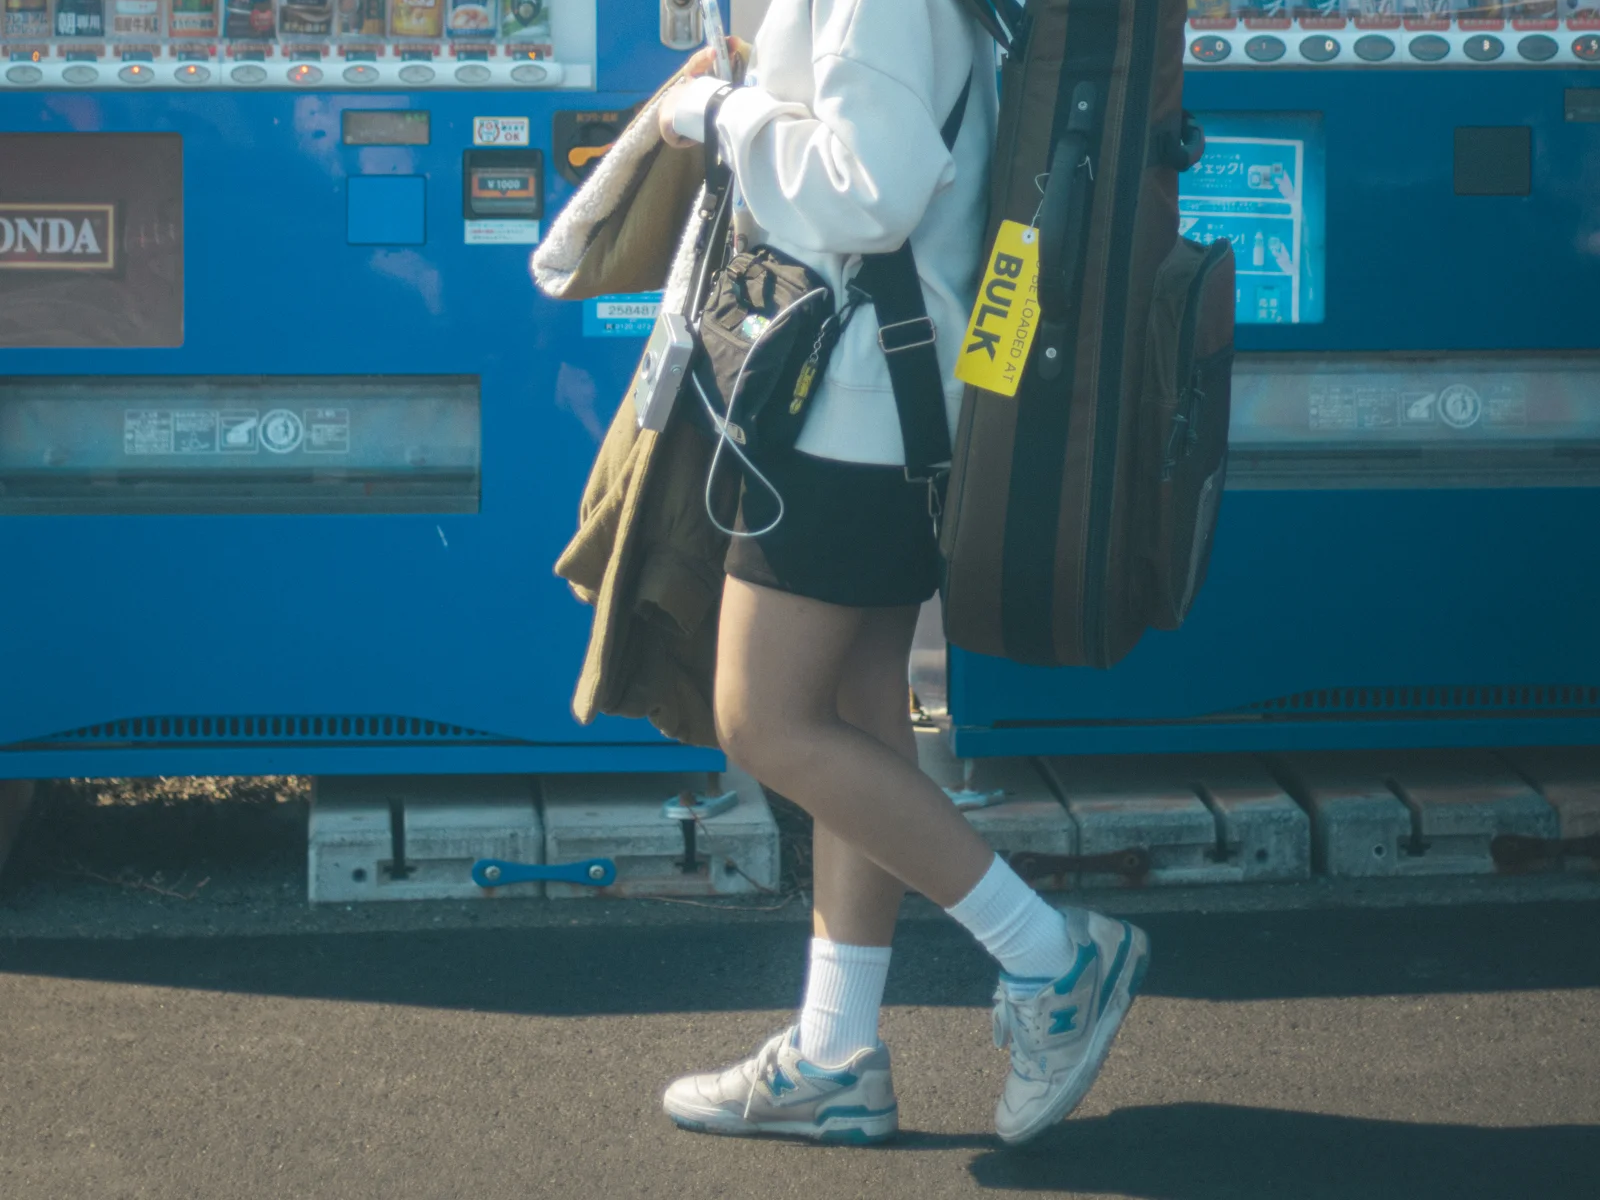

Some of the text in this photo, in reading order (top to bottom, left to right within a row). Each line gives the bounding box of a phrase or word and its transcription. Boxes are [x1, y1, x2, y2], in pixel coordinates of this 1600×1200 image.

[58, 12, 101, 36] 朝専用
[504, 132, 521, 141] OK
[1192, 161, 1244, 176] チェック!
[966, 251, 1024, 363] BULK
[1010, 297, 1037, 359] LOADED
[1002, 361, 1017, 384] AT
